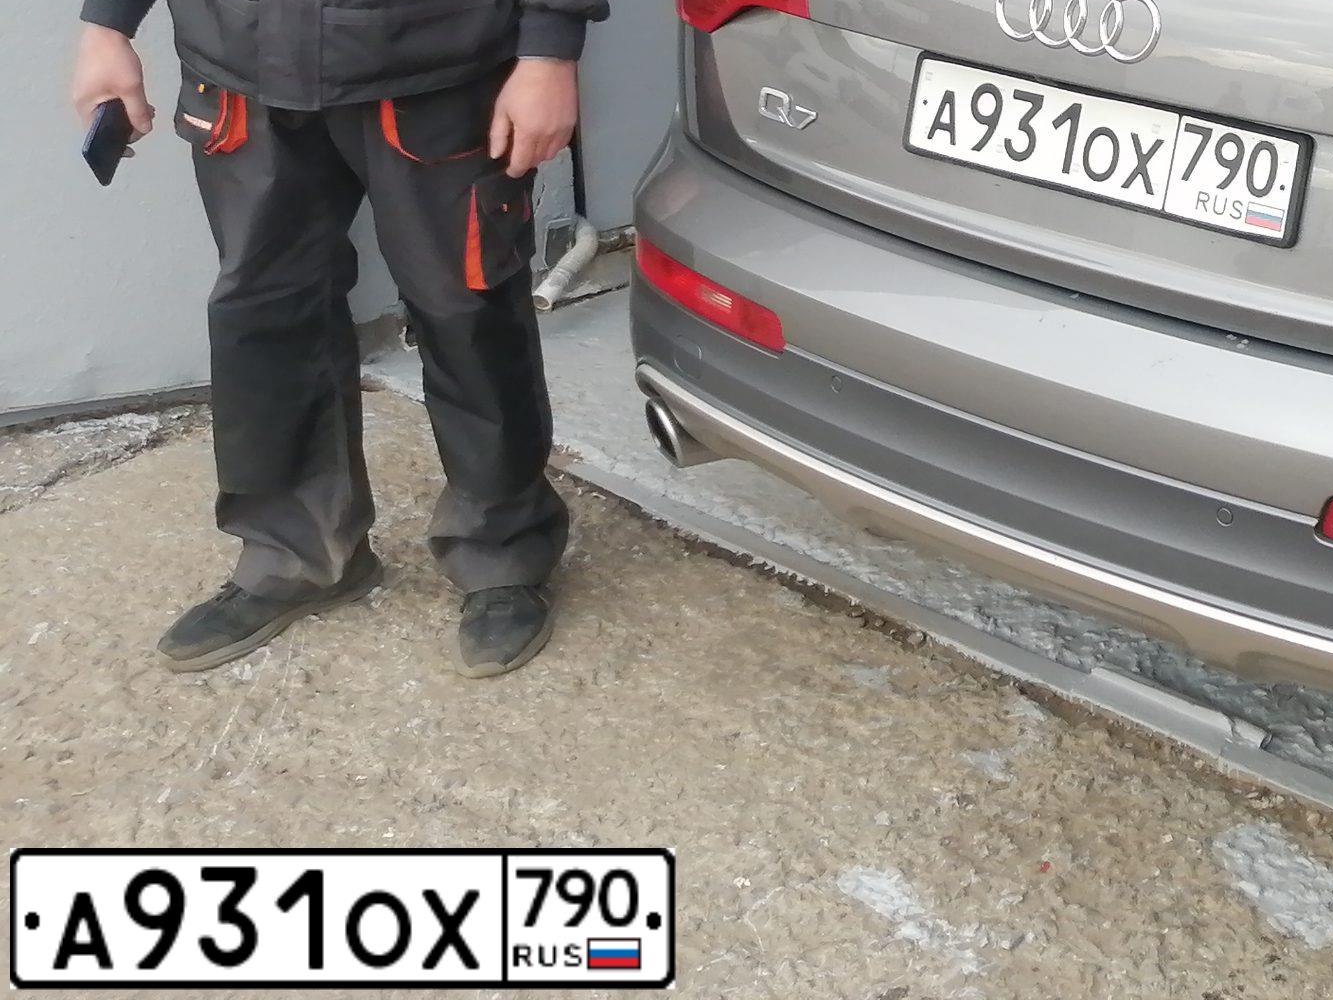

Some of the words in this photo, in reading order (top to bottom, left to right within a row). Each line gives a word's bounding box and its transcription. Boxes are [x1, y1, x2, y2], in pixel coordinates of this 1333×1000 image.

[759, 86, 818, 131] Q7
[1184, 123, 1280, 199] 790
[1195, 191, 1243, 220] RUS
